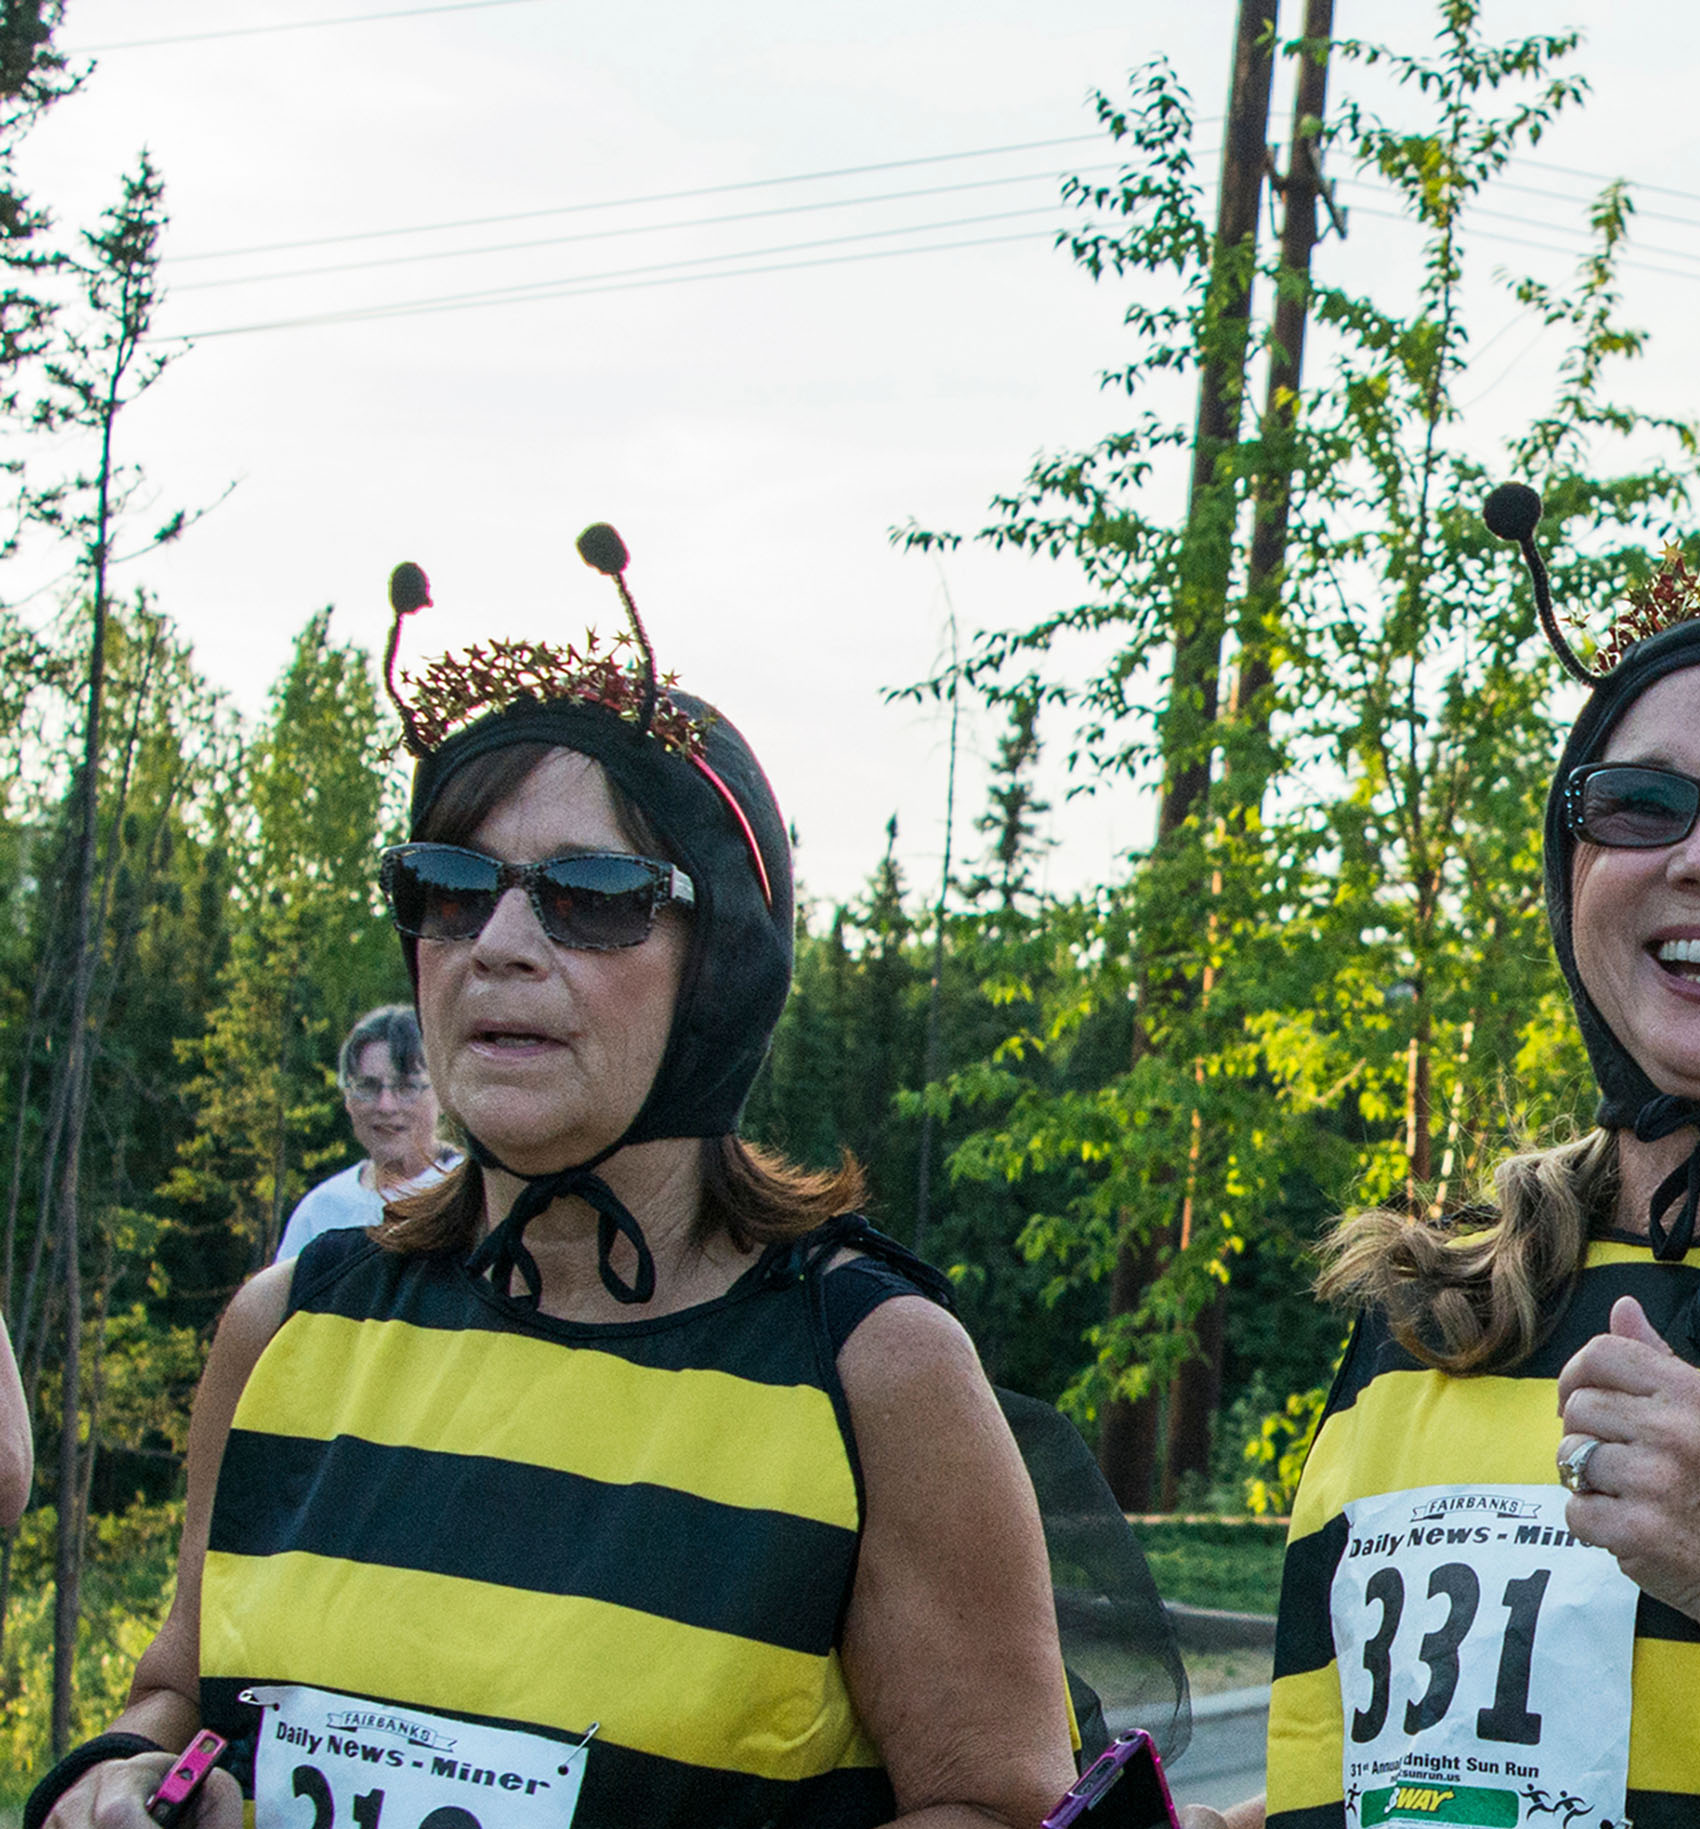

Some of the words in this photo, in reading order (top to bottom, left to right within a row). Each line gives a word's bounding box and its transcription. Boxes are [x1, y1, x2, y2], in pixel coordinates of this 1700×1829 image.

[1429, 1497, 1518, 1515] FAIRBANKS
[1348, 1533, 1404, 1558] Daily
[1407, 1526, 1491, 1549] News
[1351, 1562, 1551, 1746] 331
[343, 1714, 431, 1743] FAIRBANKS
[276, 1721, 323, 1755] Daily
[327, 1735, 404, 1768] News
[430, 1756, 551, 1796] Miner
[1467, 1757, 1499, 1774] Sun
[1506, 1762, 1540, 1779] Run
